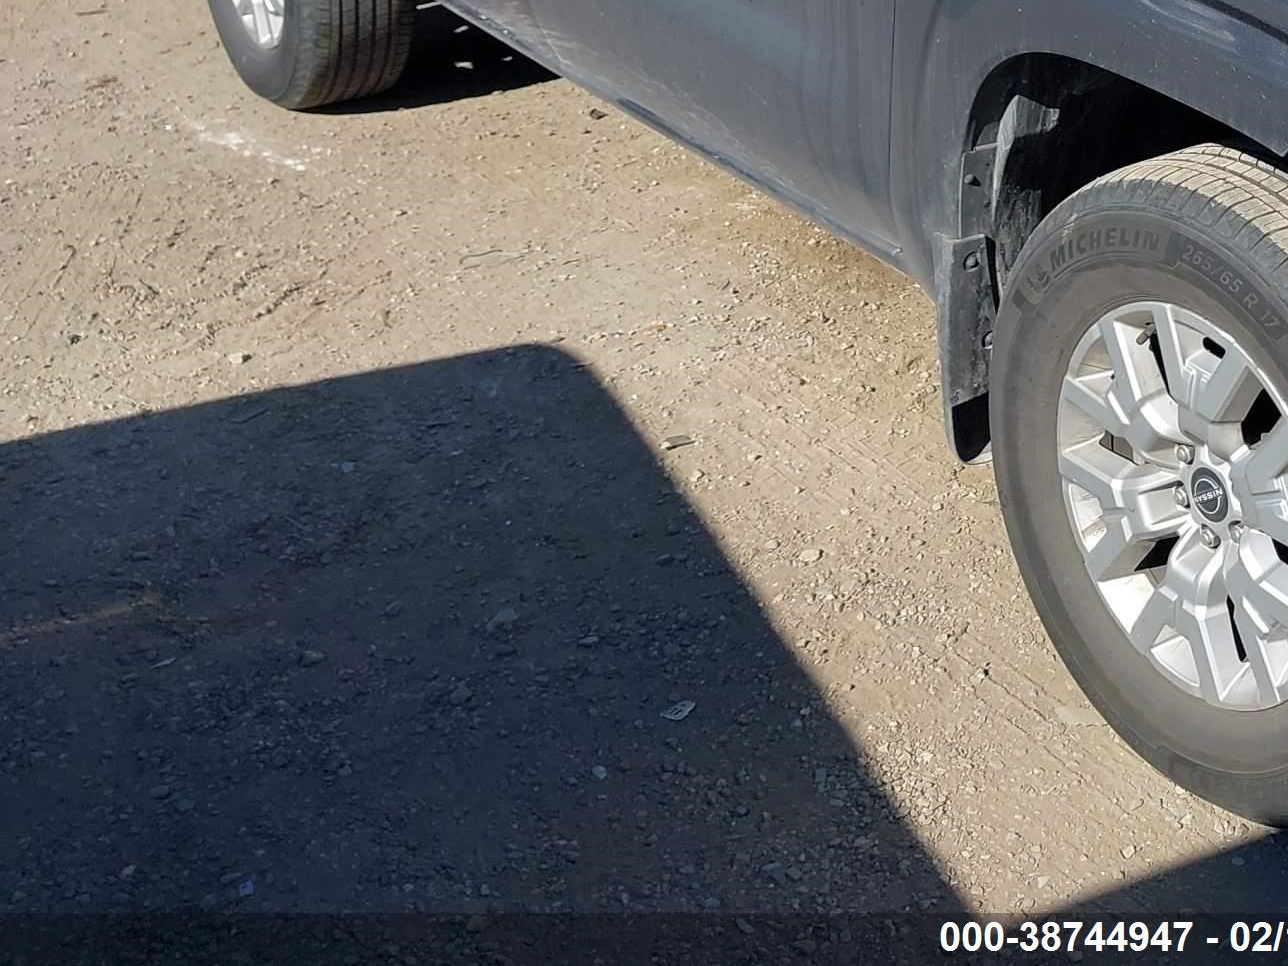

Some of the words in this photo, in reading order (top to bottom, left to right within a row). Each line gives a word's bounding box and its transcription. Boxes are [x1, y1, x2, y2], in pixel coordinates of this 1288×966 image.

[1049, 227, 1161, 270] MICHELIN
[1182, 244, 1244, 293] 265/65
[1243, 293, 1259, 309] R
[1261, 310, 1281, 329] 17
